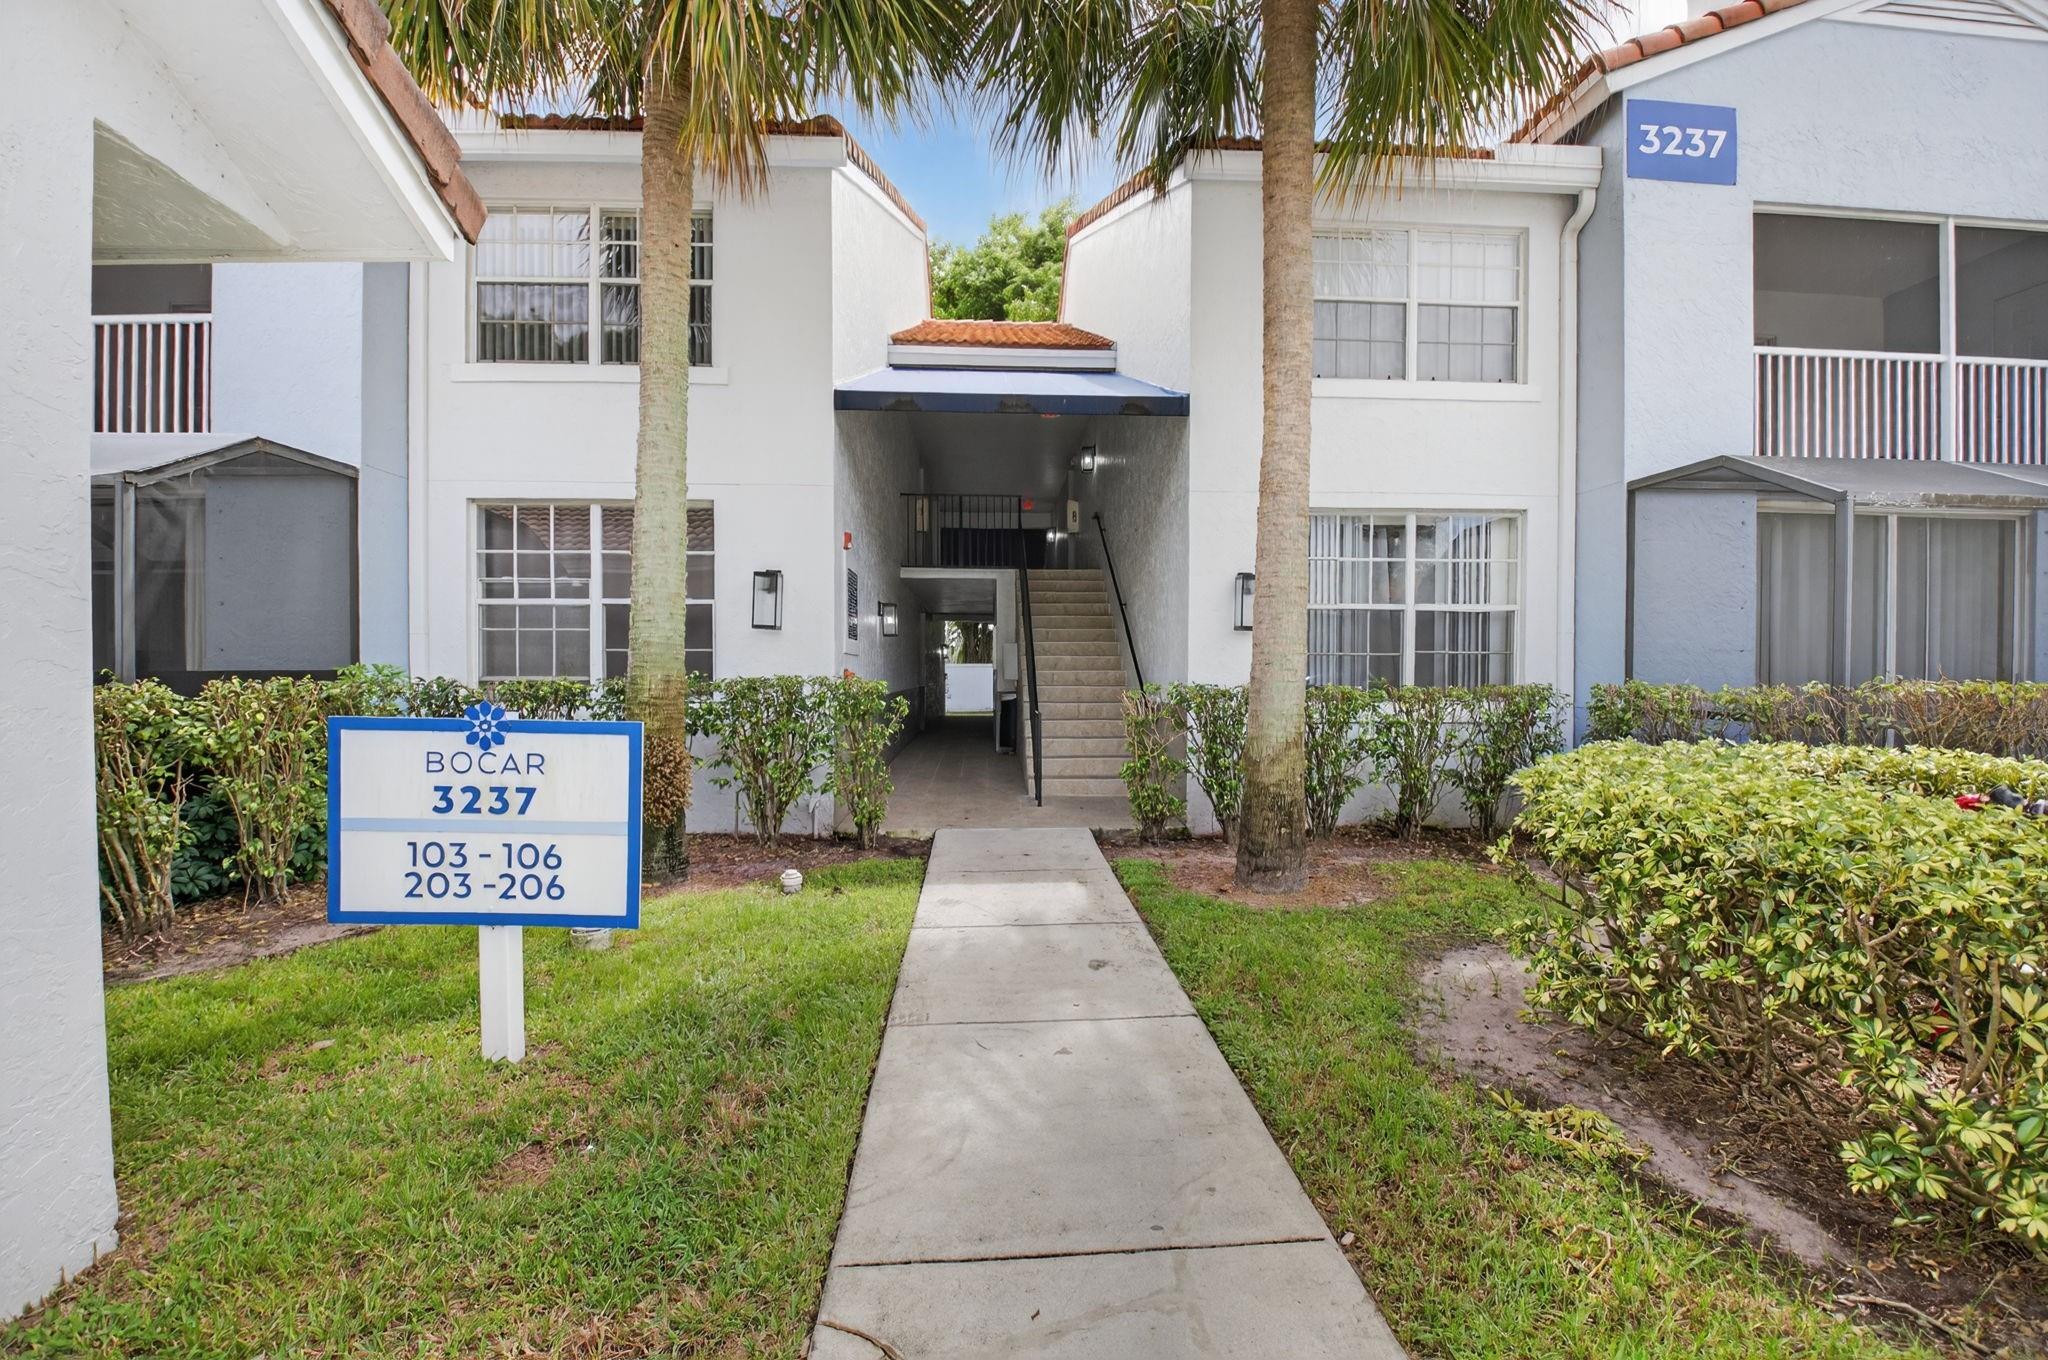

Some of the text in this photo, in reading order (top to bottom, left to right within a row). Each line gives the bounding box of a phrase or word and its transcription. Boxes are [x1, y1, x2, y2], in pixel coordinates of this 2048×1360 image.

[1639, 124, 1728, 159] 3237
[426, 751, 545, 775] BOCAR
[431, 785, 537, 816] 3237
